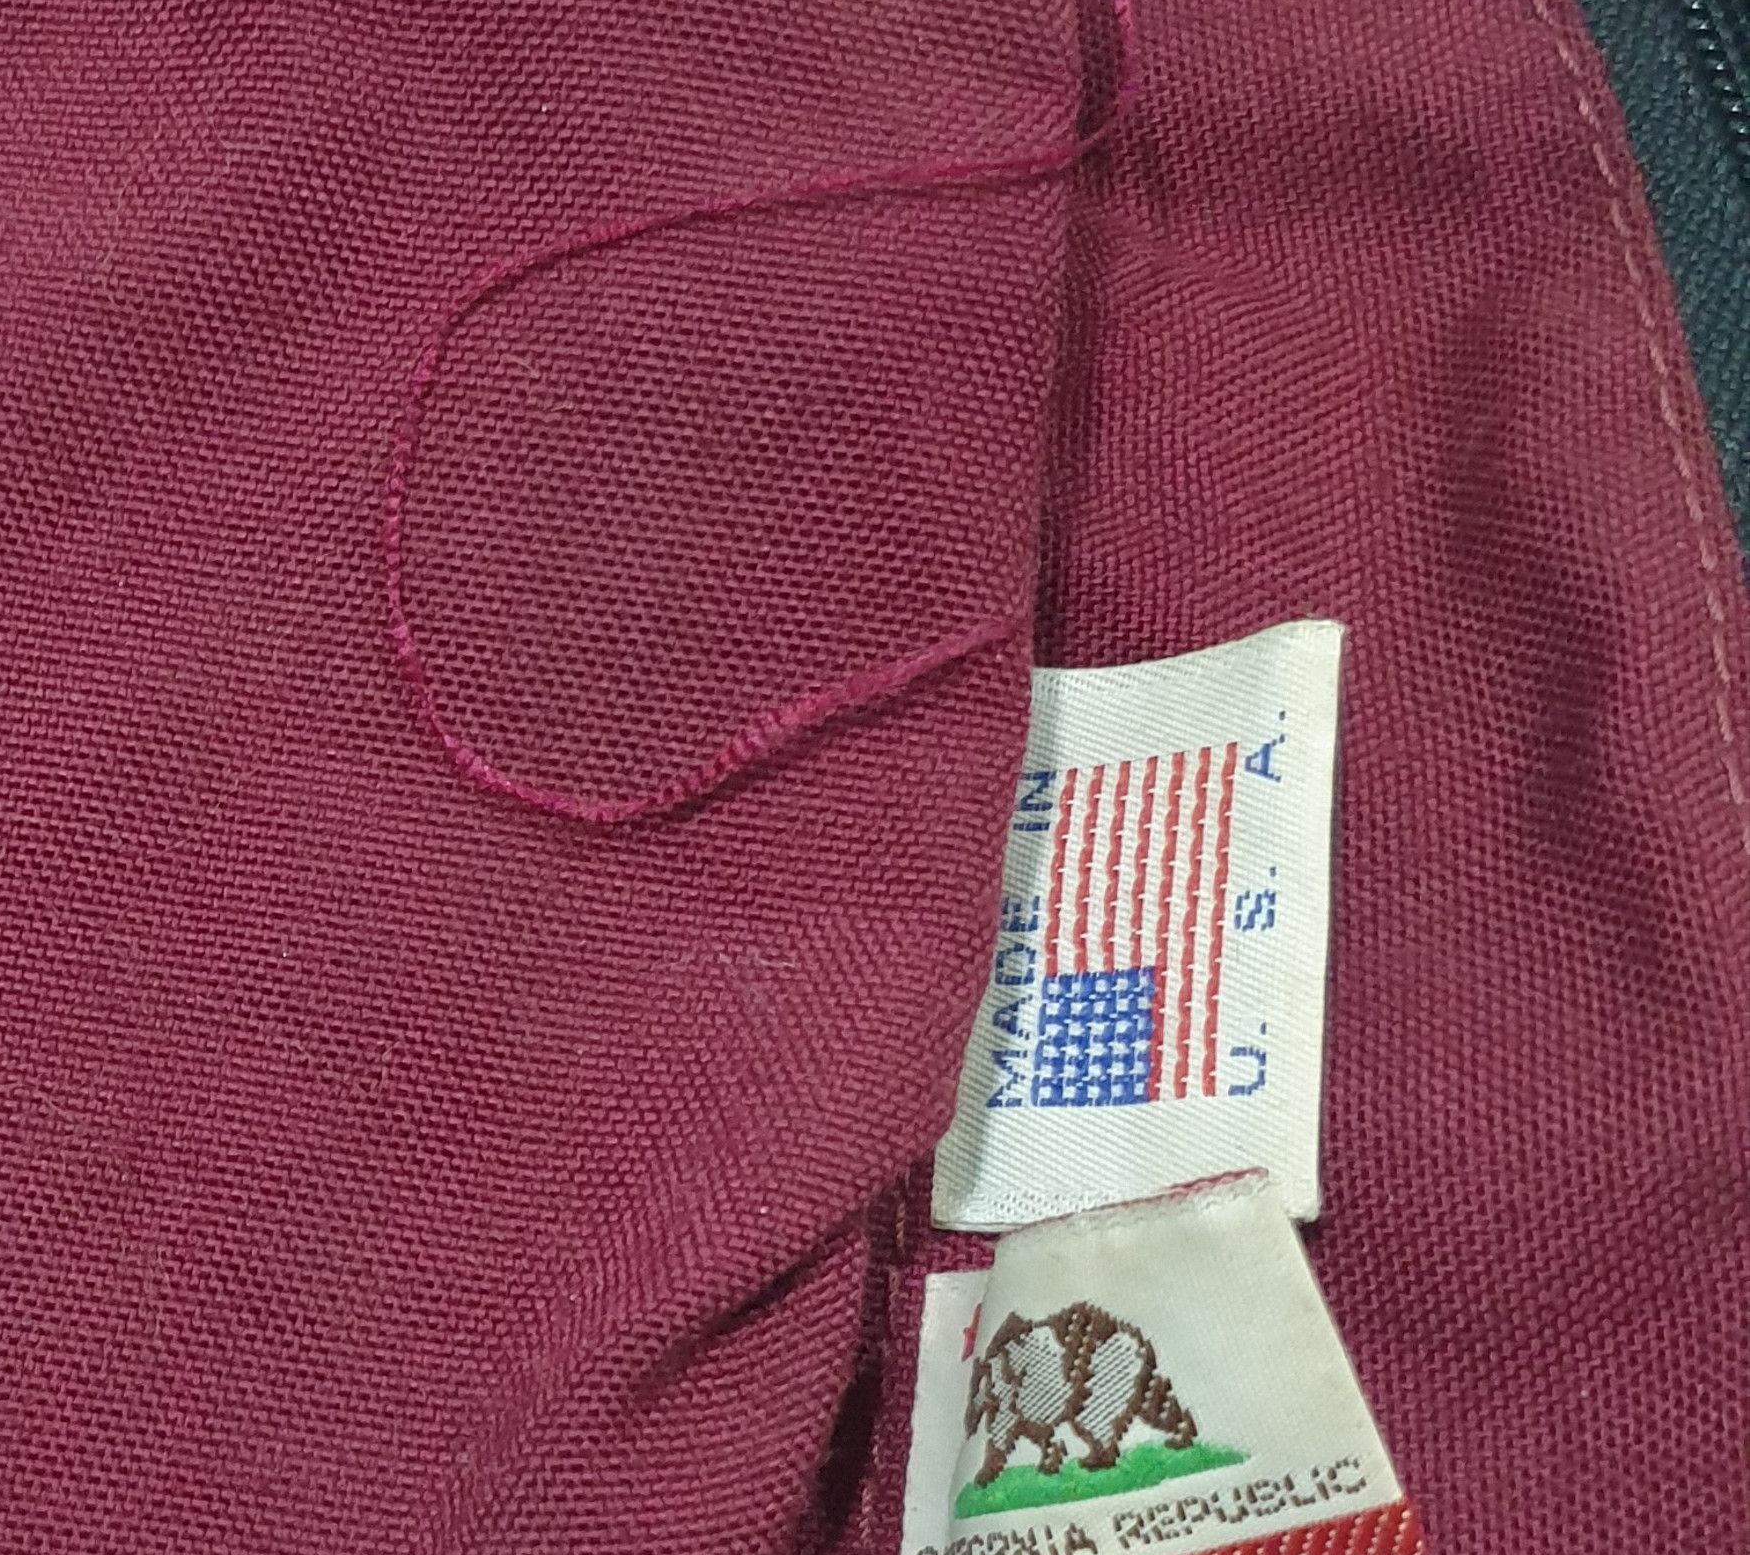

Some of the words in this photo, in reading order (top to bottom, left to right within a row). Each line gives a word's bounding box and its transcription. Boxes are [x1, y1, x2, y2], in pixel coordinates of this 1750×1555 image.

[1012, 770, 1057, 832] IN
[985, 895, 1041, 1109] MADE
[1113, 1455, 1369, 1551] REPUBLIC
